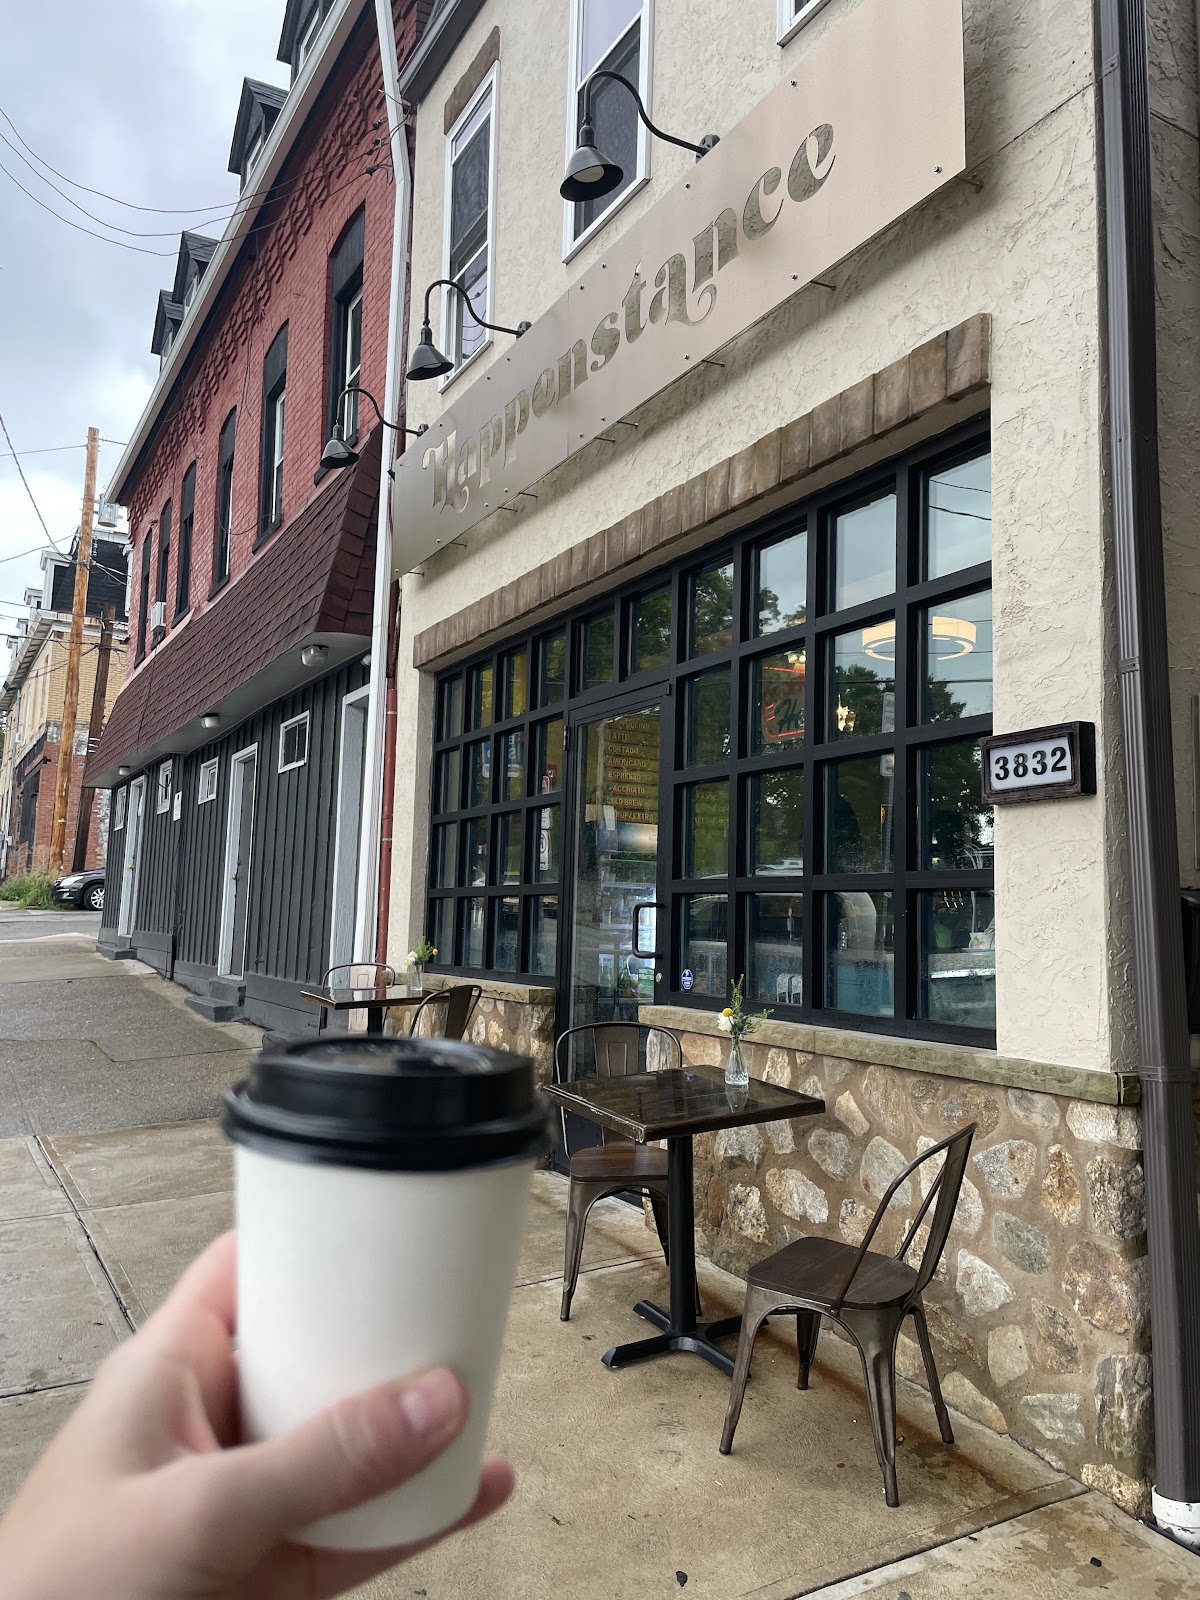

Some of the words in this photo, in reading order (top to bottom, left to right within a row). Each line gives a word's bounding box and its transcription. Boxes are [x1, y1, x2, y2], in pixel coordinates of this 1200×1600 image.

[422, 123, 836, 514] Happenstance
[607, 731, 630, 741] LATTE
[607, 745, 639, 754] CORTADO
[607, 758, 646, 768] AMERICANO
[994, 746, 1067, 781] 3832
[607, 771, 641, 781] ESPRESSO
[608, 784, 646, 795] ACCHIATO
[606, 797, 623, 805] COLD
[624, 798, 643, 807] BREW
